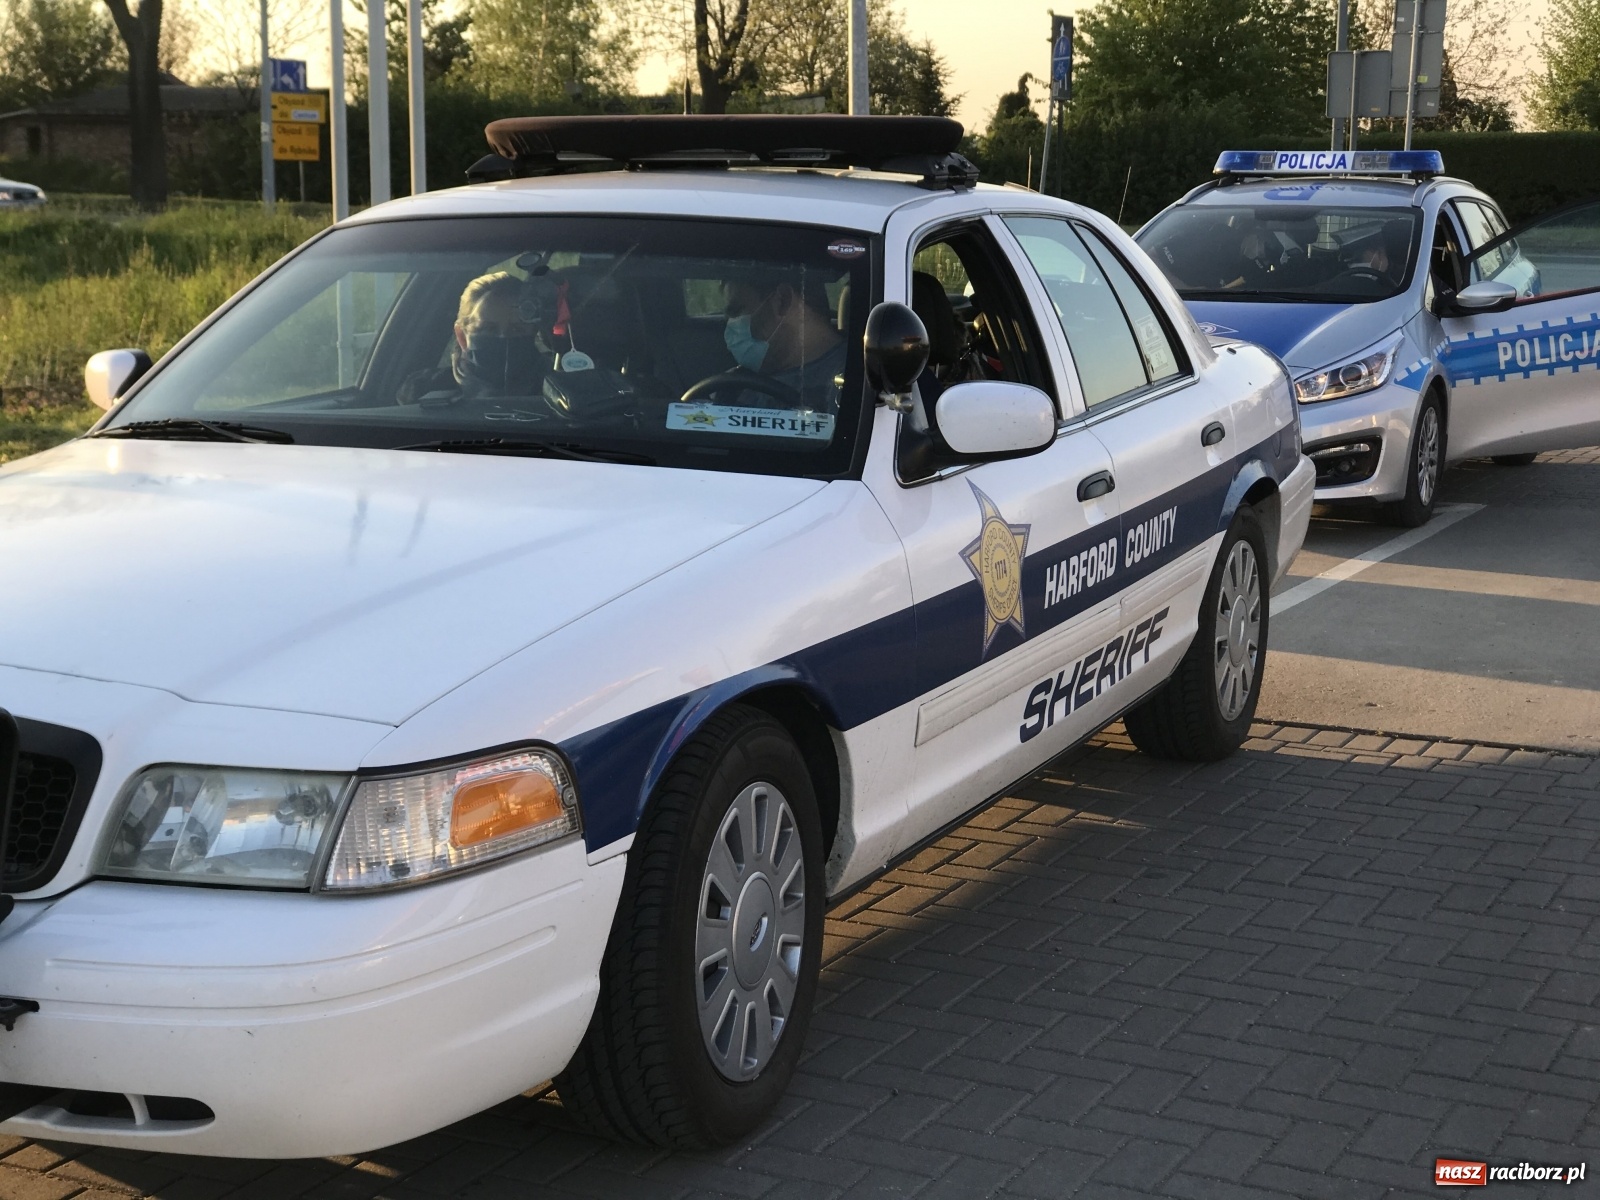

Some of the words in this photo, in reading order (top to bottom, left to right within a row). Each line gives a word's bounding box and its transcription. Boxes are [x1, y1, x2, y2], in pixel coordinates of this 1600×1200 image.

[1277, 153, 1348, 170] POLICJA
[719, 407, 782, 416] Maryland
[728, 414, 828, 433] SHERIFF
[984, 527, 998, 574] HARFORD
[1043, 536, 1118, 610] HARFORD
[1124, 505, 1178, 569] COUNTY
[1019, 605, 1171, 744] SHERIFF
